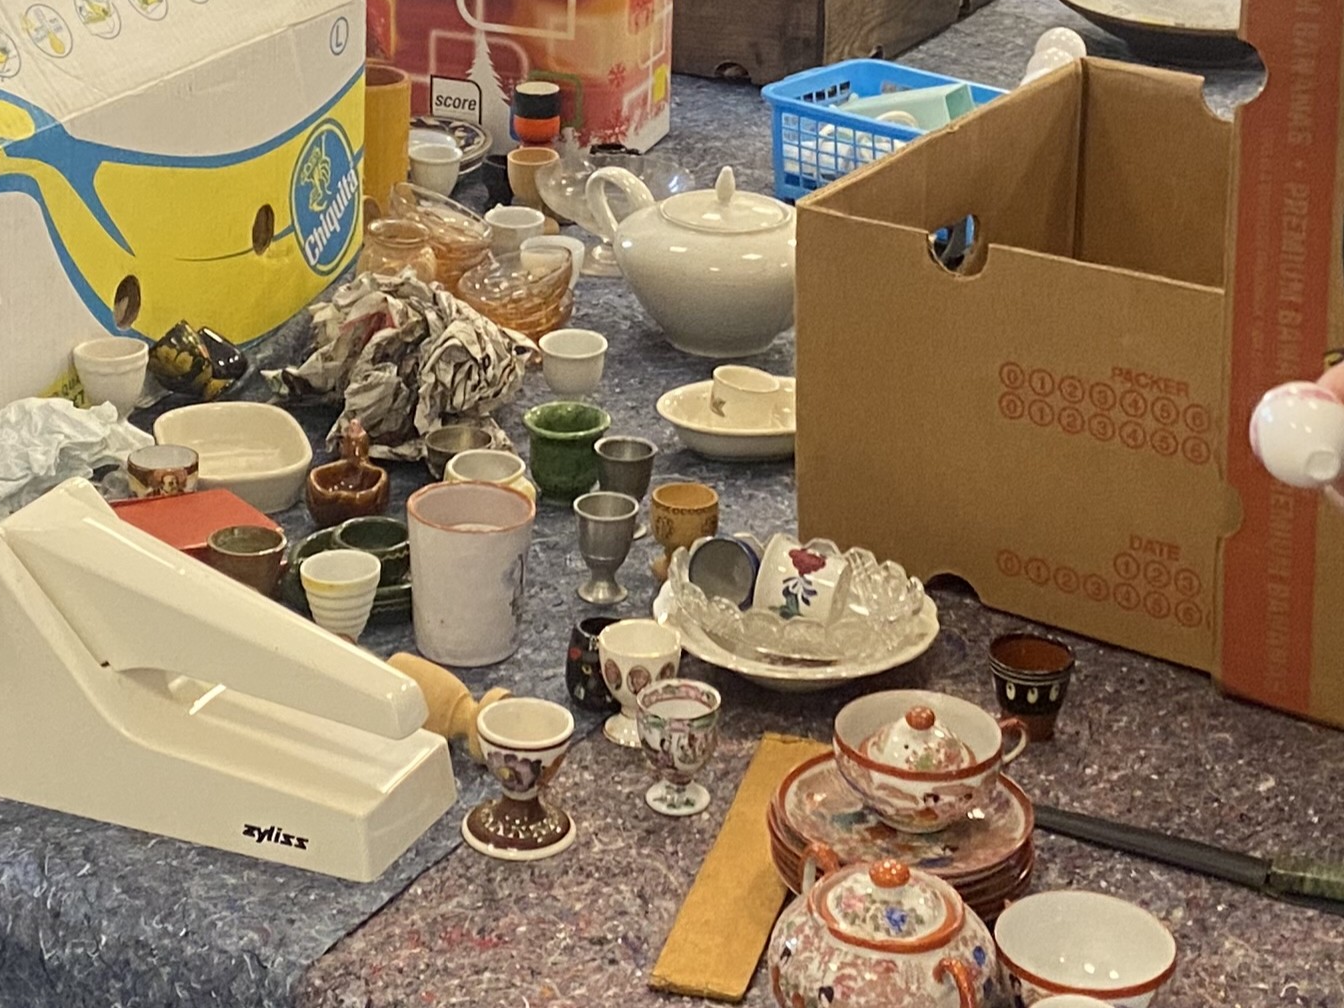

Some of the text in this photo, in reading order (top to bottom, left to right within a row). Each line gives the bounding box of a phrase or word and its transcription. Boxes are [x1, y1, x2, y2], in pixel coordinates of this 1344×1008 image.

[434, 94, 478, 112] score
[304, 167, 359, 267] Chiquita
[1110, 365, 1191, 398] PACKER
[1129, 533, 1181, 562] DATE
[241, 823, 310, 851] zyliss
